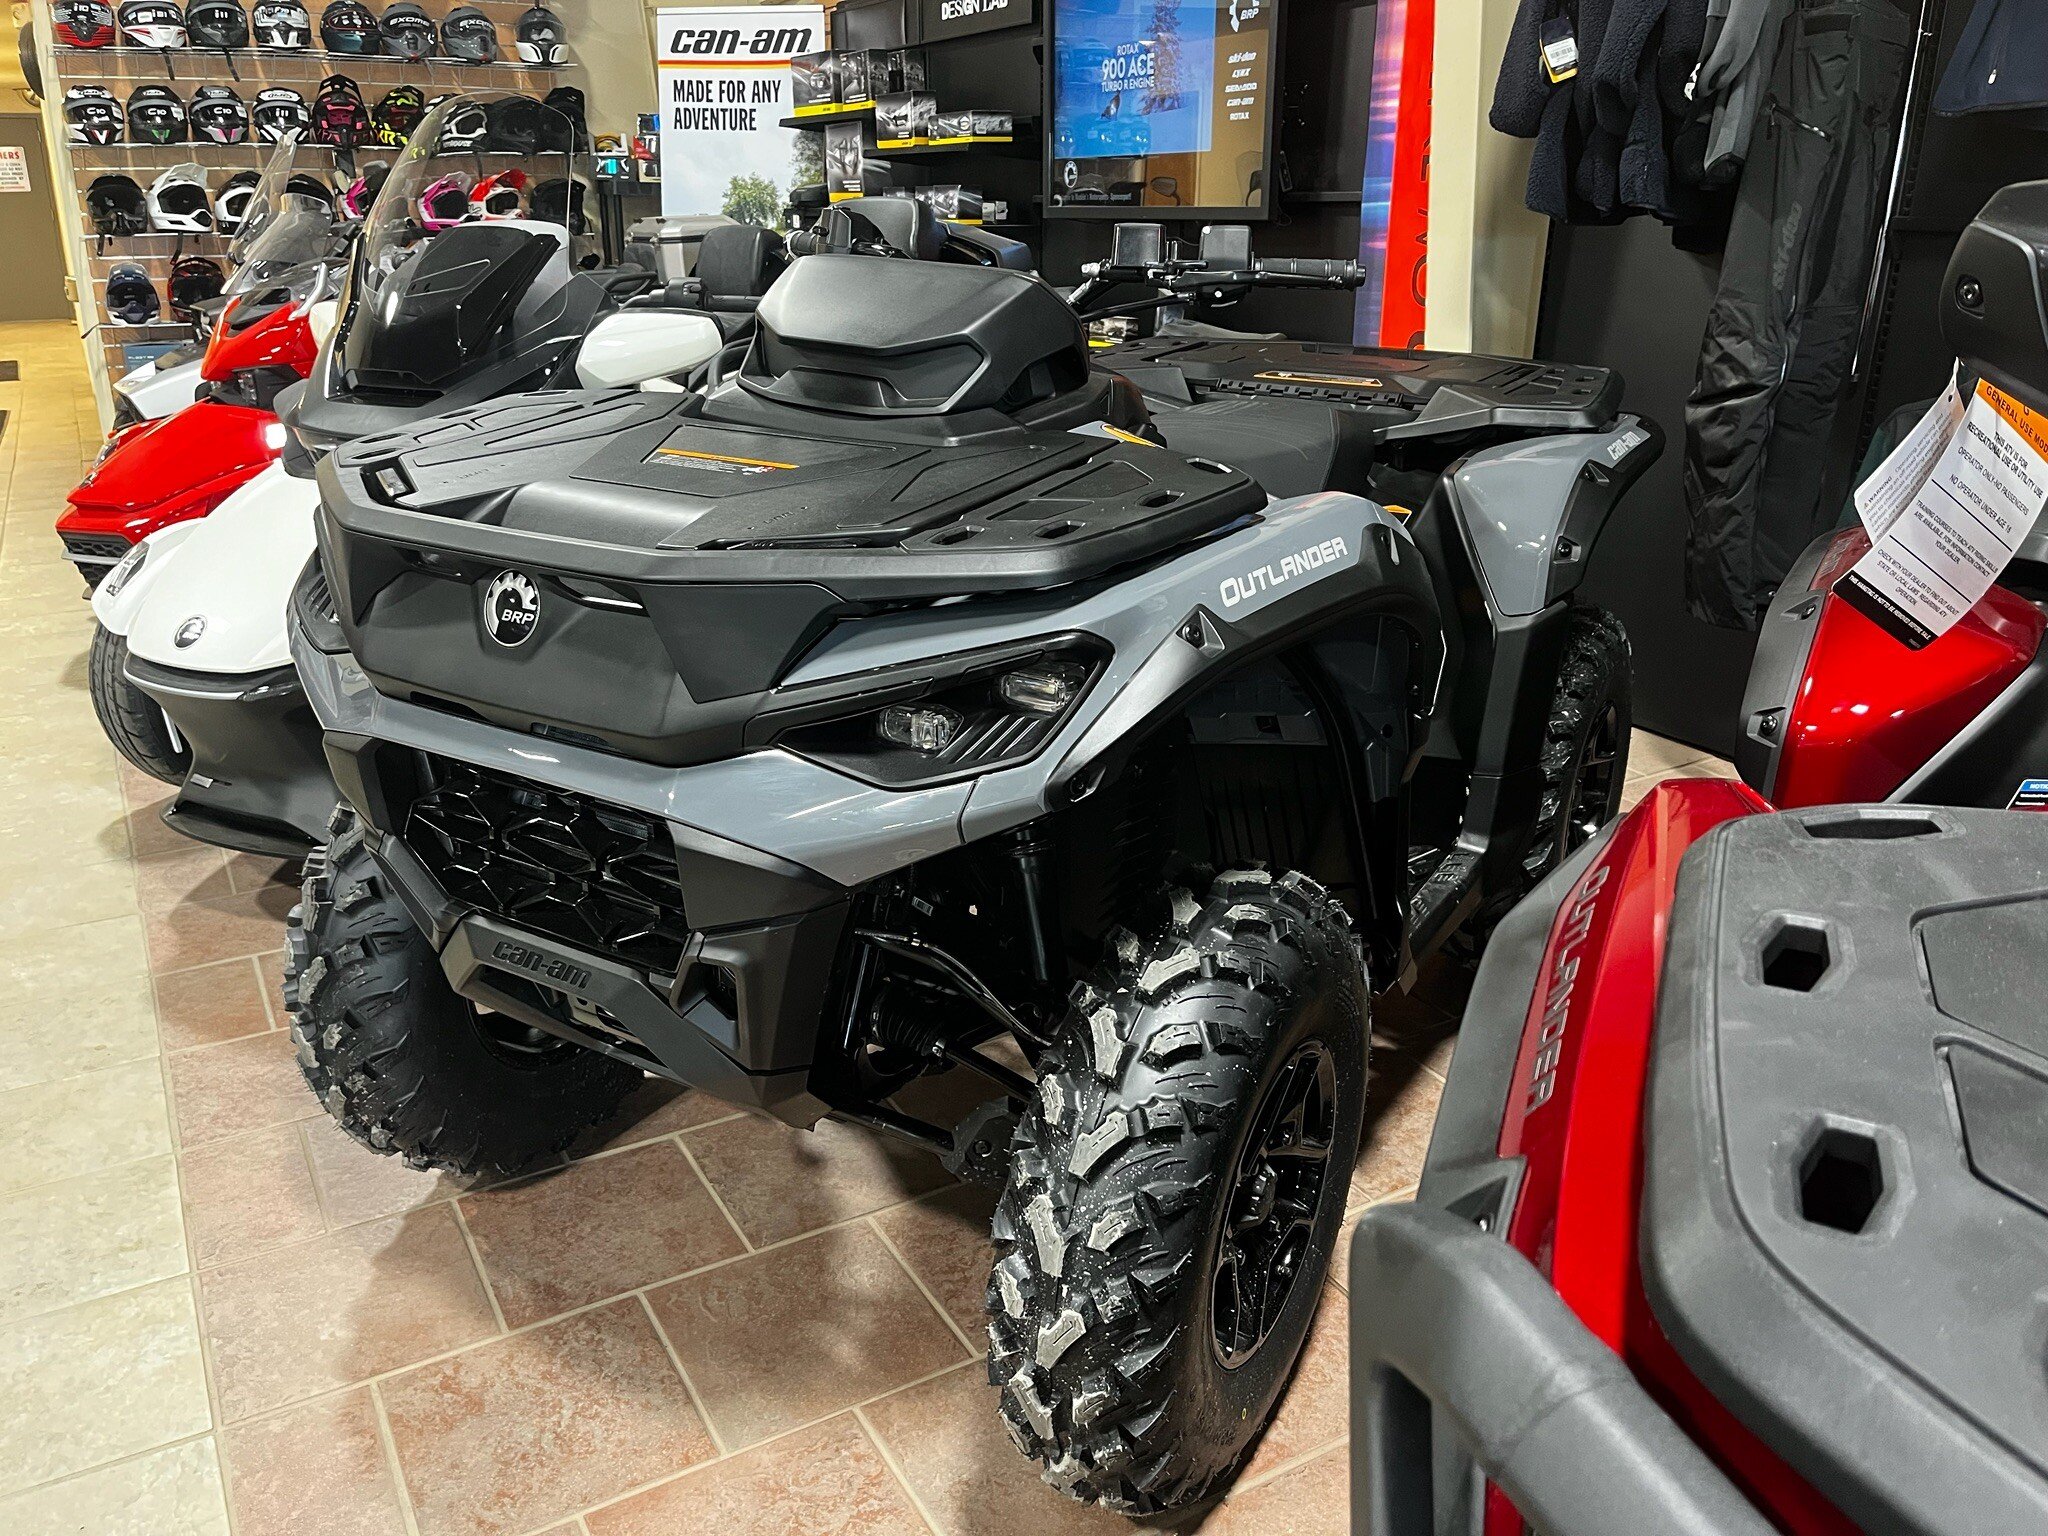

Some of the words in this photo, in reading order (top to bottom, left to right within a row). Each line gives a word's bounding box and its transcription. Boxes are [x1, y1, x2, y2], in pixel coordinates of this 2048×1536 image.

[942, 0, 980, 20] DESIGN
[1240, 8, 1260, 20] BRP
[670, 28, 812, 54] can-am
[1117, 42, 1139, 56] ROTAX
[1102, 57, 1126, 80] 900
[1128, 52, 1155, 78] ACE
[673, 79, 713, 103] MADE
[718, 79, 746, 103] FOR
[751, 79, 782, 104] ANY
[1101, 80, 1124, 93] TURBO
[1130, 76, 1155, 90] ENGINE
[673, 107, 757, 131] ADVENTURE
[1985, 385, 2020, 423] GENERAL
[2018, 418, 2034, 437] USE
[2032, 433, 2048, 453] MOD
[1607, 431, 1641, 460] can-am
[1967, 421, 2002, 459] RECREATIONAL
[2001, 453, 2011, 467] USE
[2010, 462, 2018, 474] OR
[2017, 469, 2034, 489] UTILITY
[2033, 485, 2043, 498] USE
[1993, 431, 2005, 447] THIS
[2005, 443, 2013, 455] ATV
[2013, 451, 2018, 460] IS
[2018, 456, 2028, 470] FOR
[1867, 474, 1892, 503] WARNING
[1958, 445, 1983, 472] OPERATOR
[2000, 485, 2029, 515] PASSENGERS
[1949, 473, 1958, 484] NO
[1957, 480, 1982, 506] OPERATOR
[1980, 501, 1997, 520] UNDER
[1996, 516, 2006, 528] AGE
[1913, 510, 1924, 521] ARE
[1942, 534, 1952, 545] FOR
[1950, 541, 1975, 564] INFORMATION
[1972, 560, 1990, 577] CONTACT
[1934, 539, 1946, 551] YOUR
[1954, 533, 1968, 547] TEACH
[1967, 544, 1975, 553] ATV
[1220, 536, 1348, 608] OUTLANDER
[1877, 548, 1893, 563] CHECK
[1900, 566, 1912, 578] YOUR
[1910, 574, 1927, 590] DEALER
[1877, 559, 1891, 573] STATE
[1895, 574, 1909, 587] LOCAL
[501, 609, 535, 624] BRP
[491, 940, 592, 990] can-am
[1524, 865, 1610, 1118] OUTLANDER
